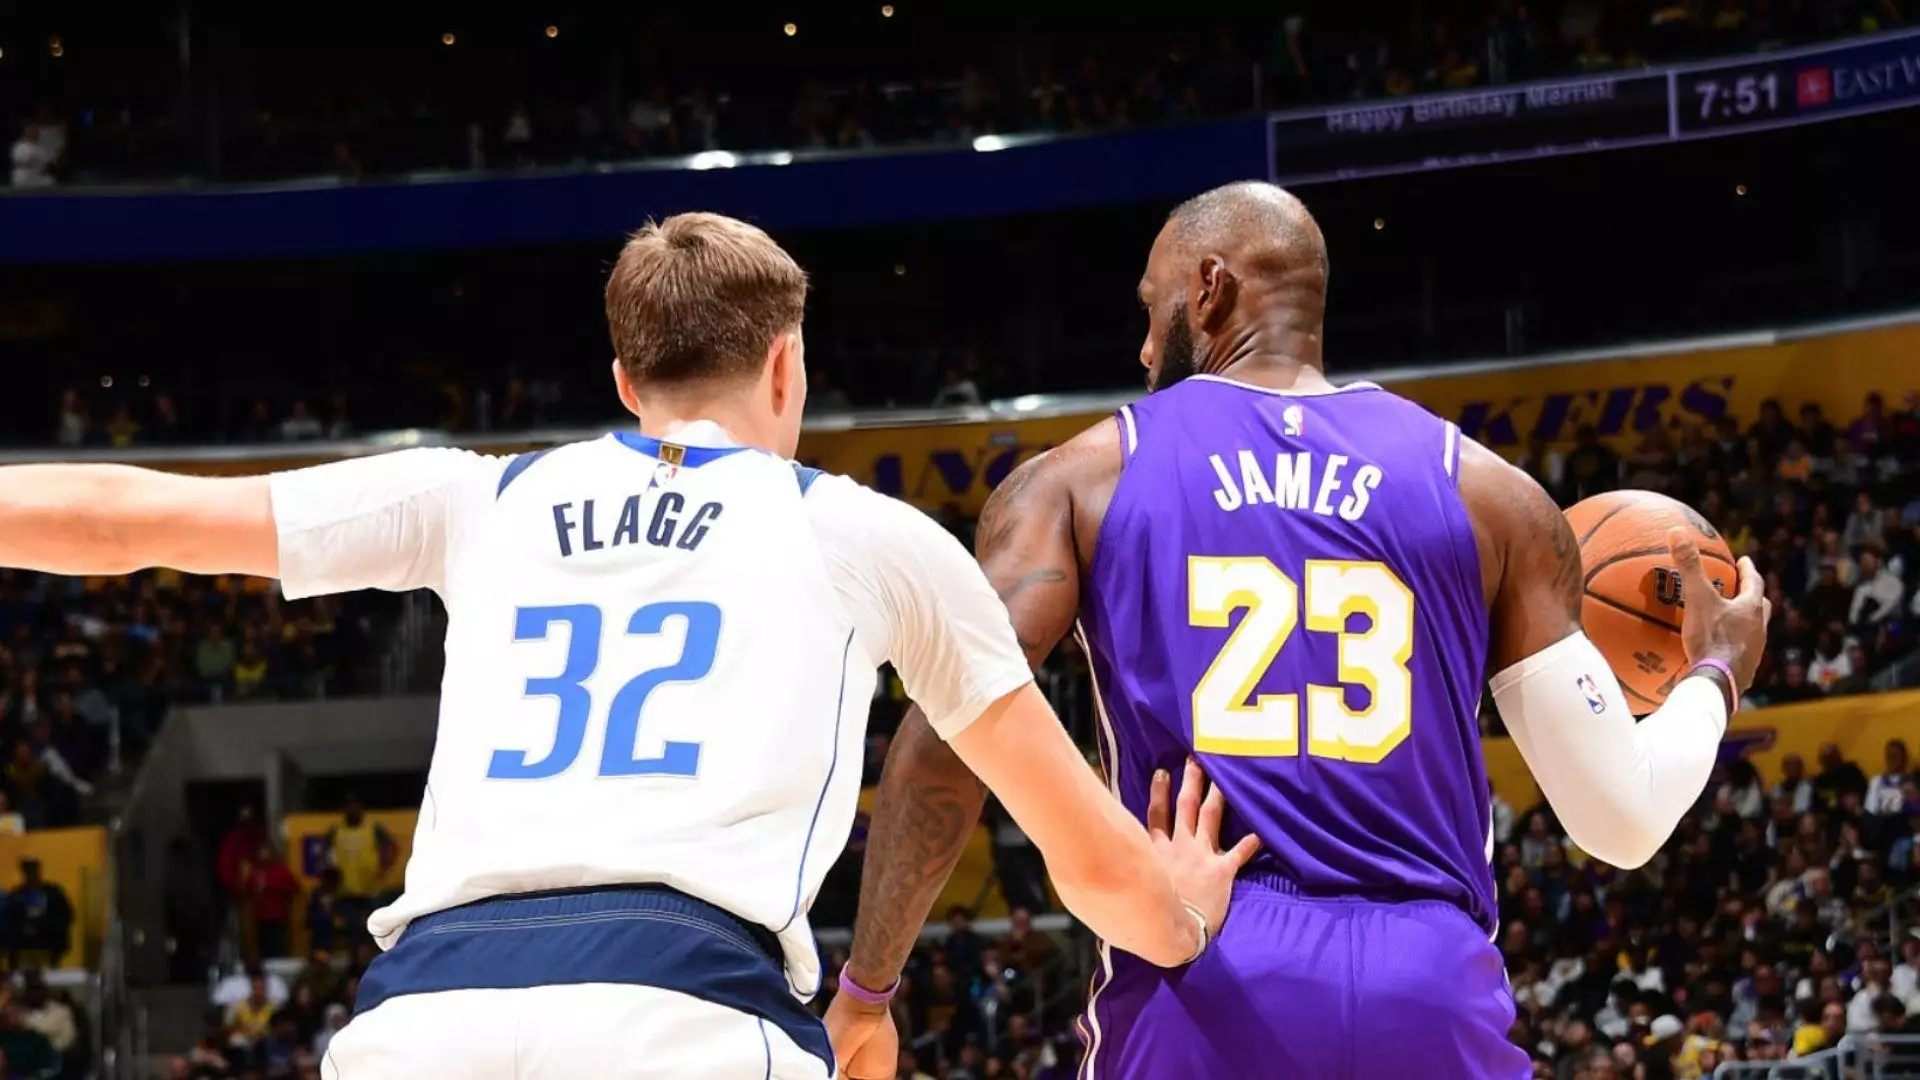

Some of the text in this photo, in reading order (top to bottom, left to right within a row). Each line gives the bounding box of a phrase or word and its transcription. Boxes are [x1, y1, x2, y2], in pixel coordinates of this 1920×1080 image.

[1326, 106, 1403, 133] Happy
[1412, 95, 1520, 124] Birthday
[1694, 71, 1780, 119] 7:51
[1208, 449, 1384, 522] JAMES
[552, 491, 725, 558] FLAGG
[486, 600, 725, 782] 32
[1187, 554, 1415, 764] 23
